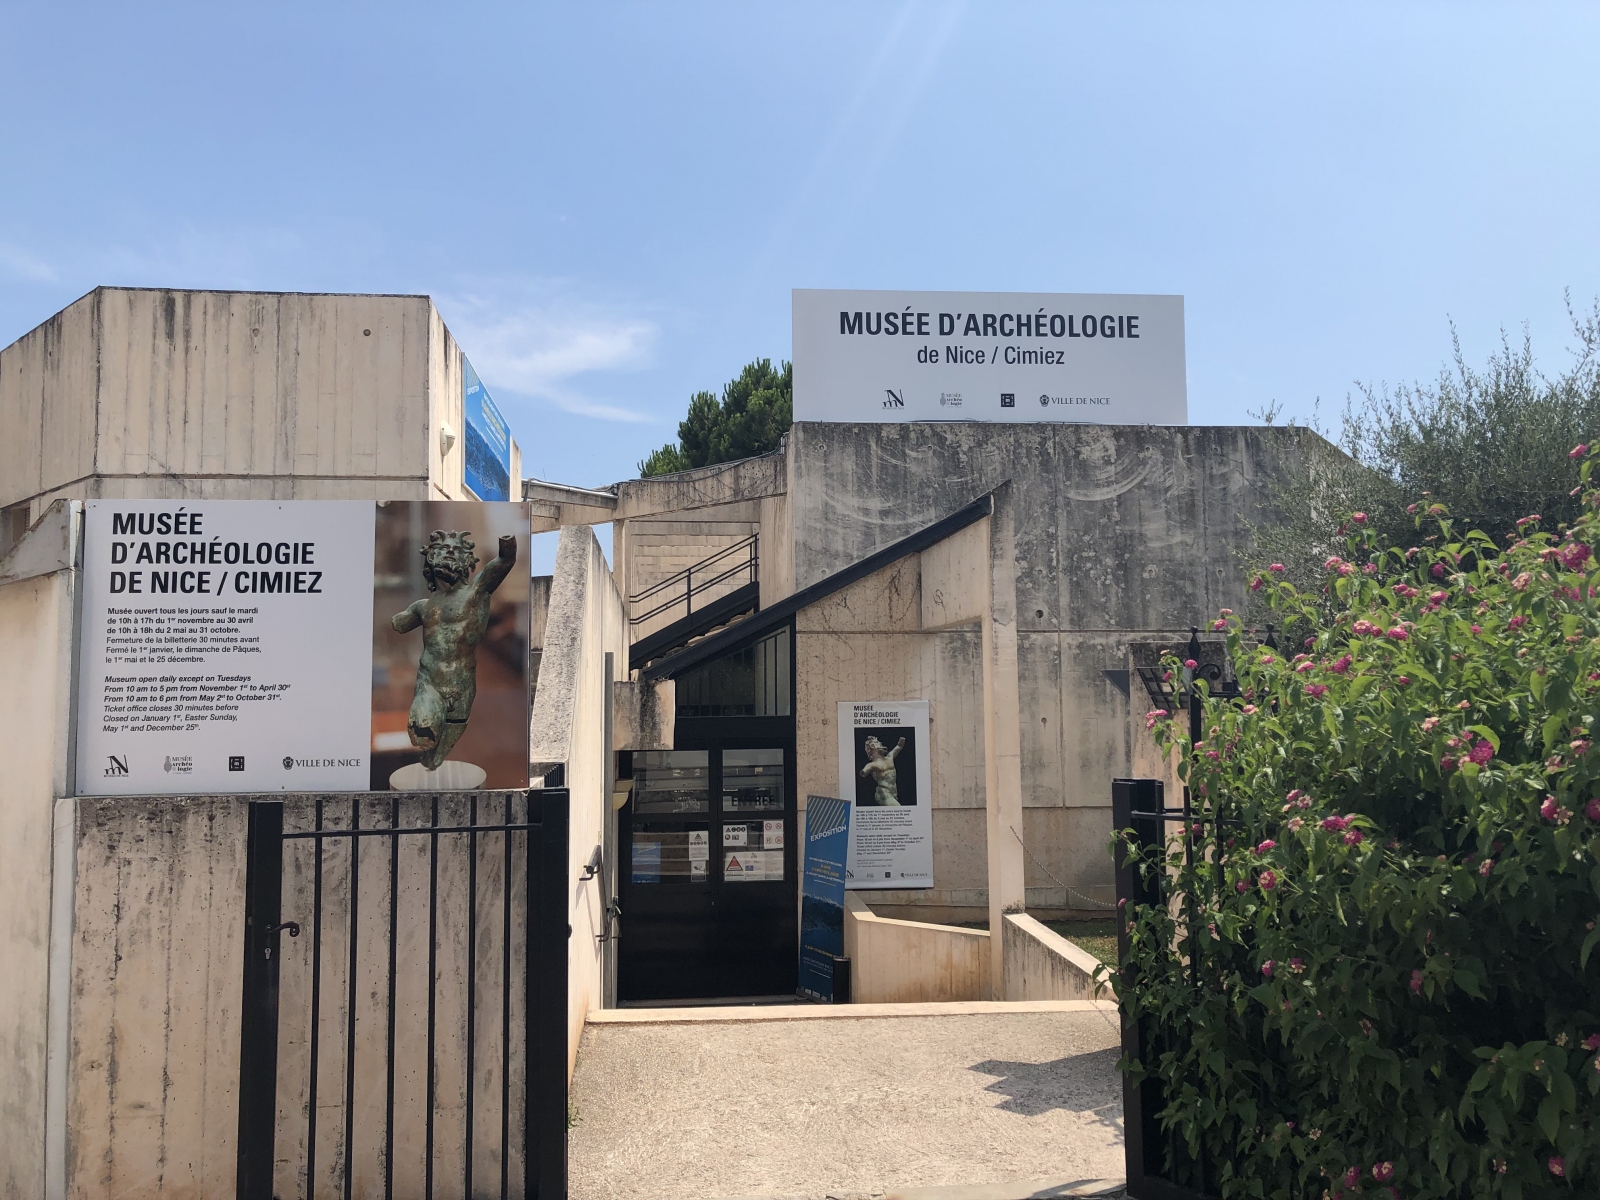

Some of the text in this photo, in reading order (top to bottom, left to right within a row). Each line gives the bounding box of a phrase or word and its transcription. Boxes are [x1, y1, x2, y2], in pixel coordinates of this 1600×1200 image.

[840, 306, 1140, 338] MUSÉE D'ARCHÉOLOGIE
[917, 345, 1065, 365] de Nice / Cimiez
[1051, 397, 1074, 405] VILLE
[1076, 397, 1087, 405] DE
[112, 507, 203, 535] MUSÉE
[111, 536, 315, 565] D'ARCHÉOLOGIE
[109, 571, 322, 596] DE NICE / CIMIEZ
[190, 607, 209, 615] jours
[149, 646, 174, 655] janvier,
[232, 645, 262, 654] Pâques,
[139, 676, 157, 684] open
[159, 675, 177, 683] daily
[179, 675, 204, 683] except
[217, 675, 251, 683] Tuesdays
[259, 684, 277, 692] April
[142, 715, 171, 723] January
[210, 714, 238, 722] Sunday,
[103, 725, 118, 733] May
[130, 724, 144, 732] and
[295, 758, 361, 768] VILLE DE NICE
[810, 825, 846, 842] EXPOSITION
